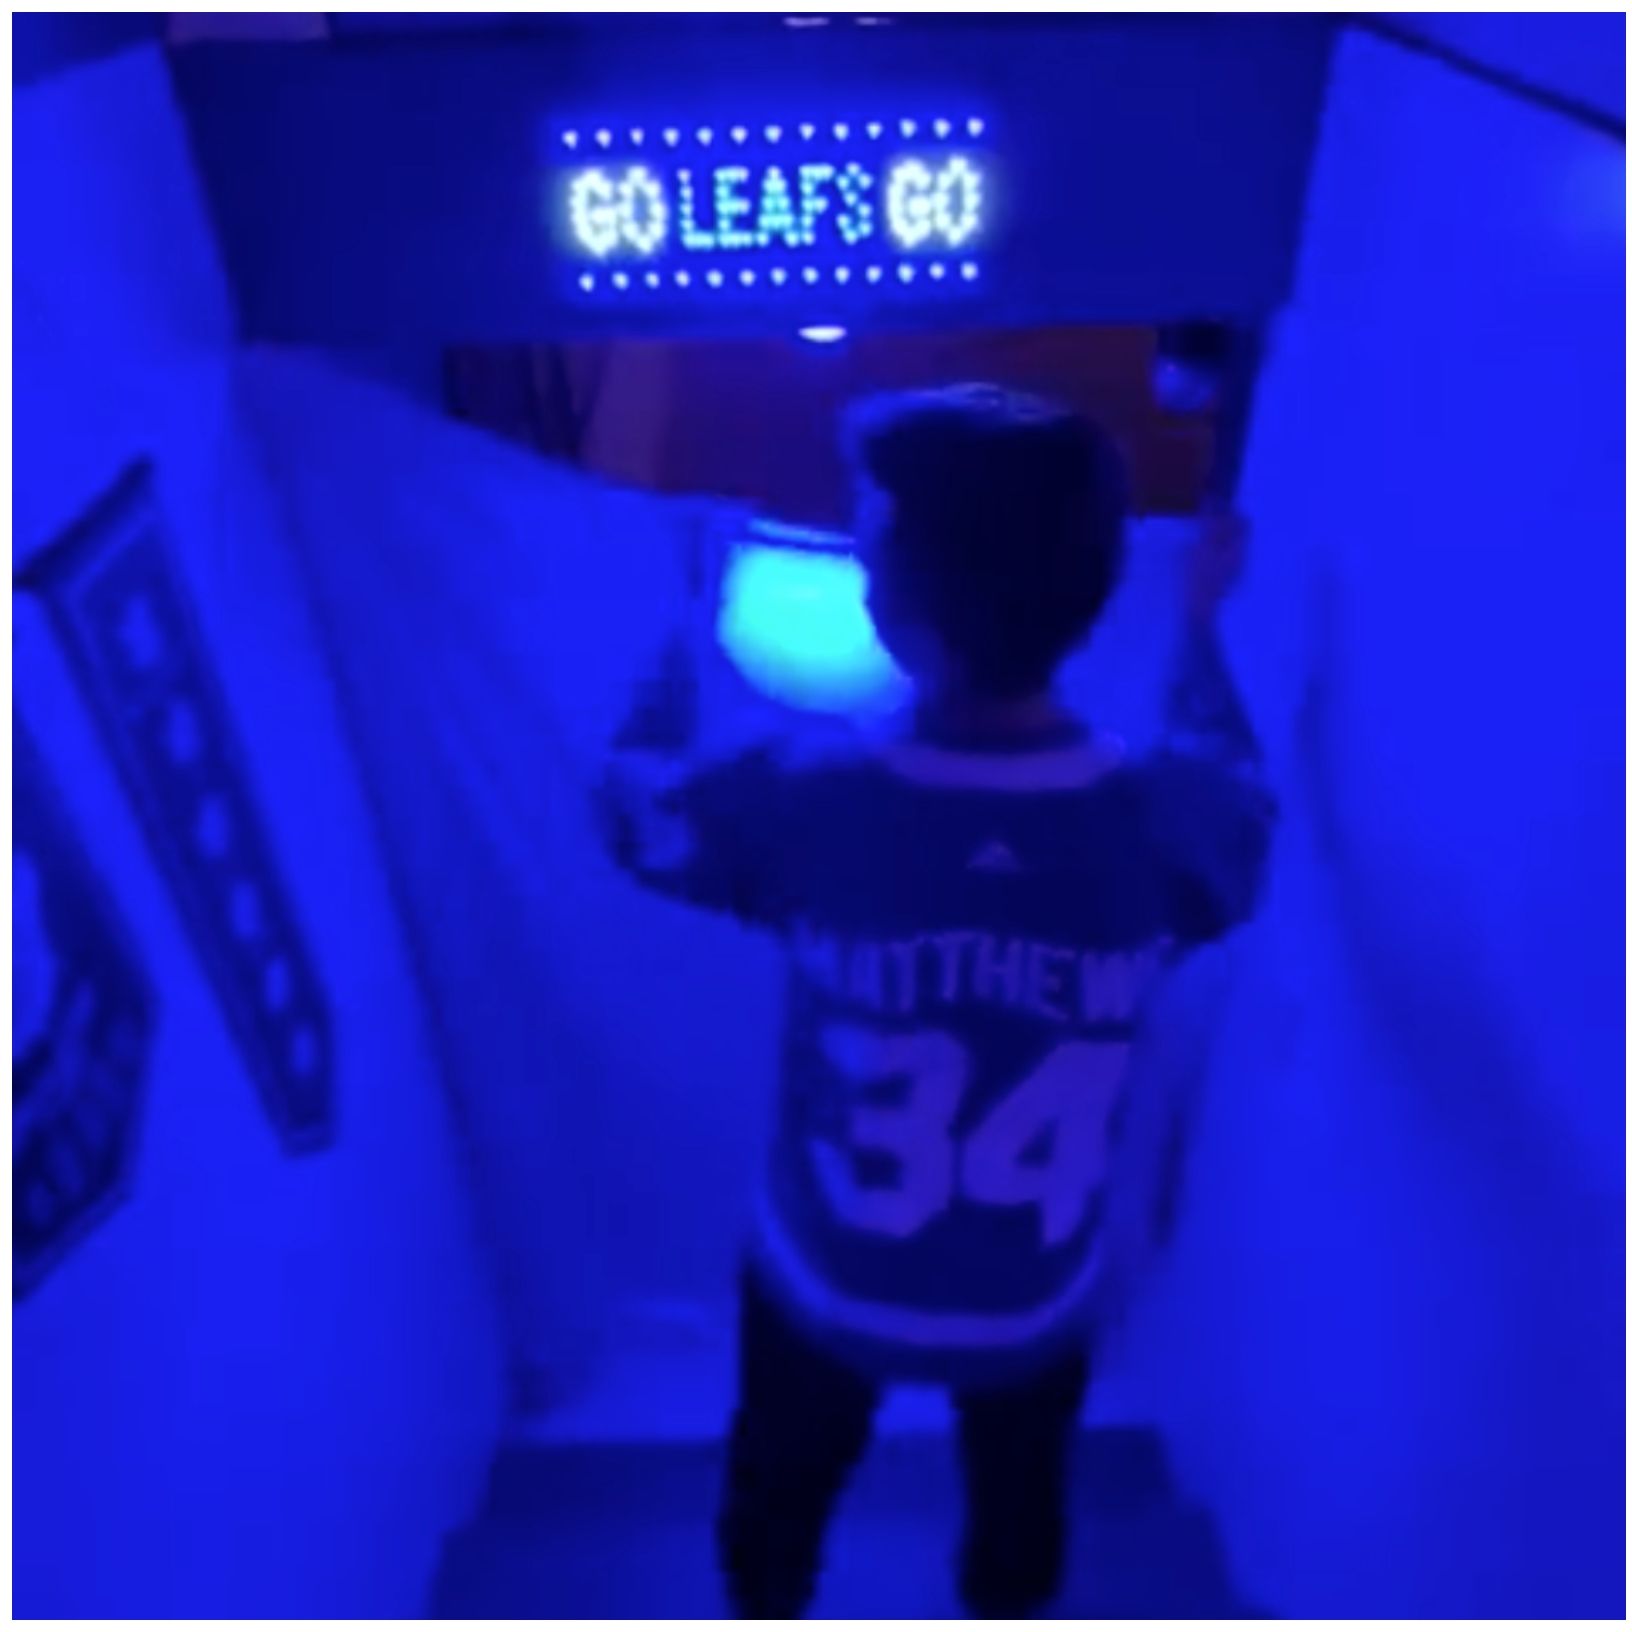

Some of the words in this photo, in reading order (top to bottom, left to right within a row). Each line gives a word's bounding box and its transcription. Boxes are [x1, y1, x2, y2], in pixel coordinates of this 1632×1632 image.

[568, 164, 668, 254] GO
[677, 160, 873, 252] LEAFS
[886, 153, 982, 248] GO
[791, 915, 1176, 1022] MATTHEW
[808, 1022, 1132, 1252] 34
